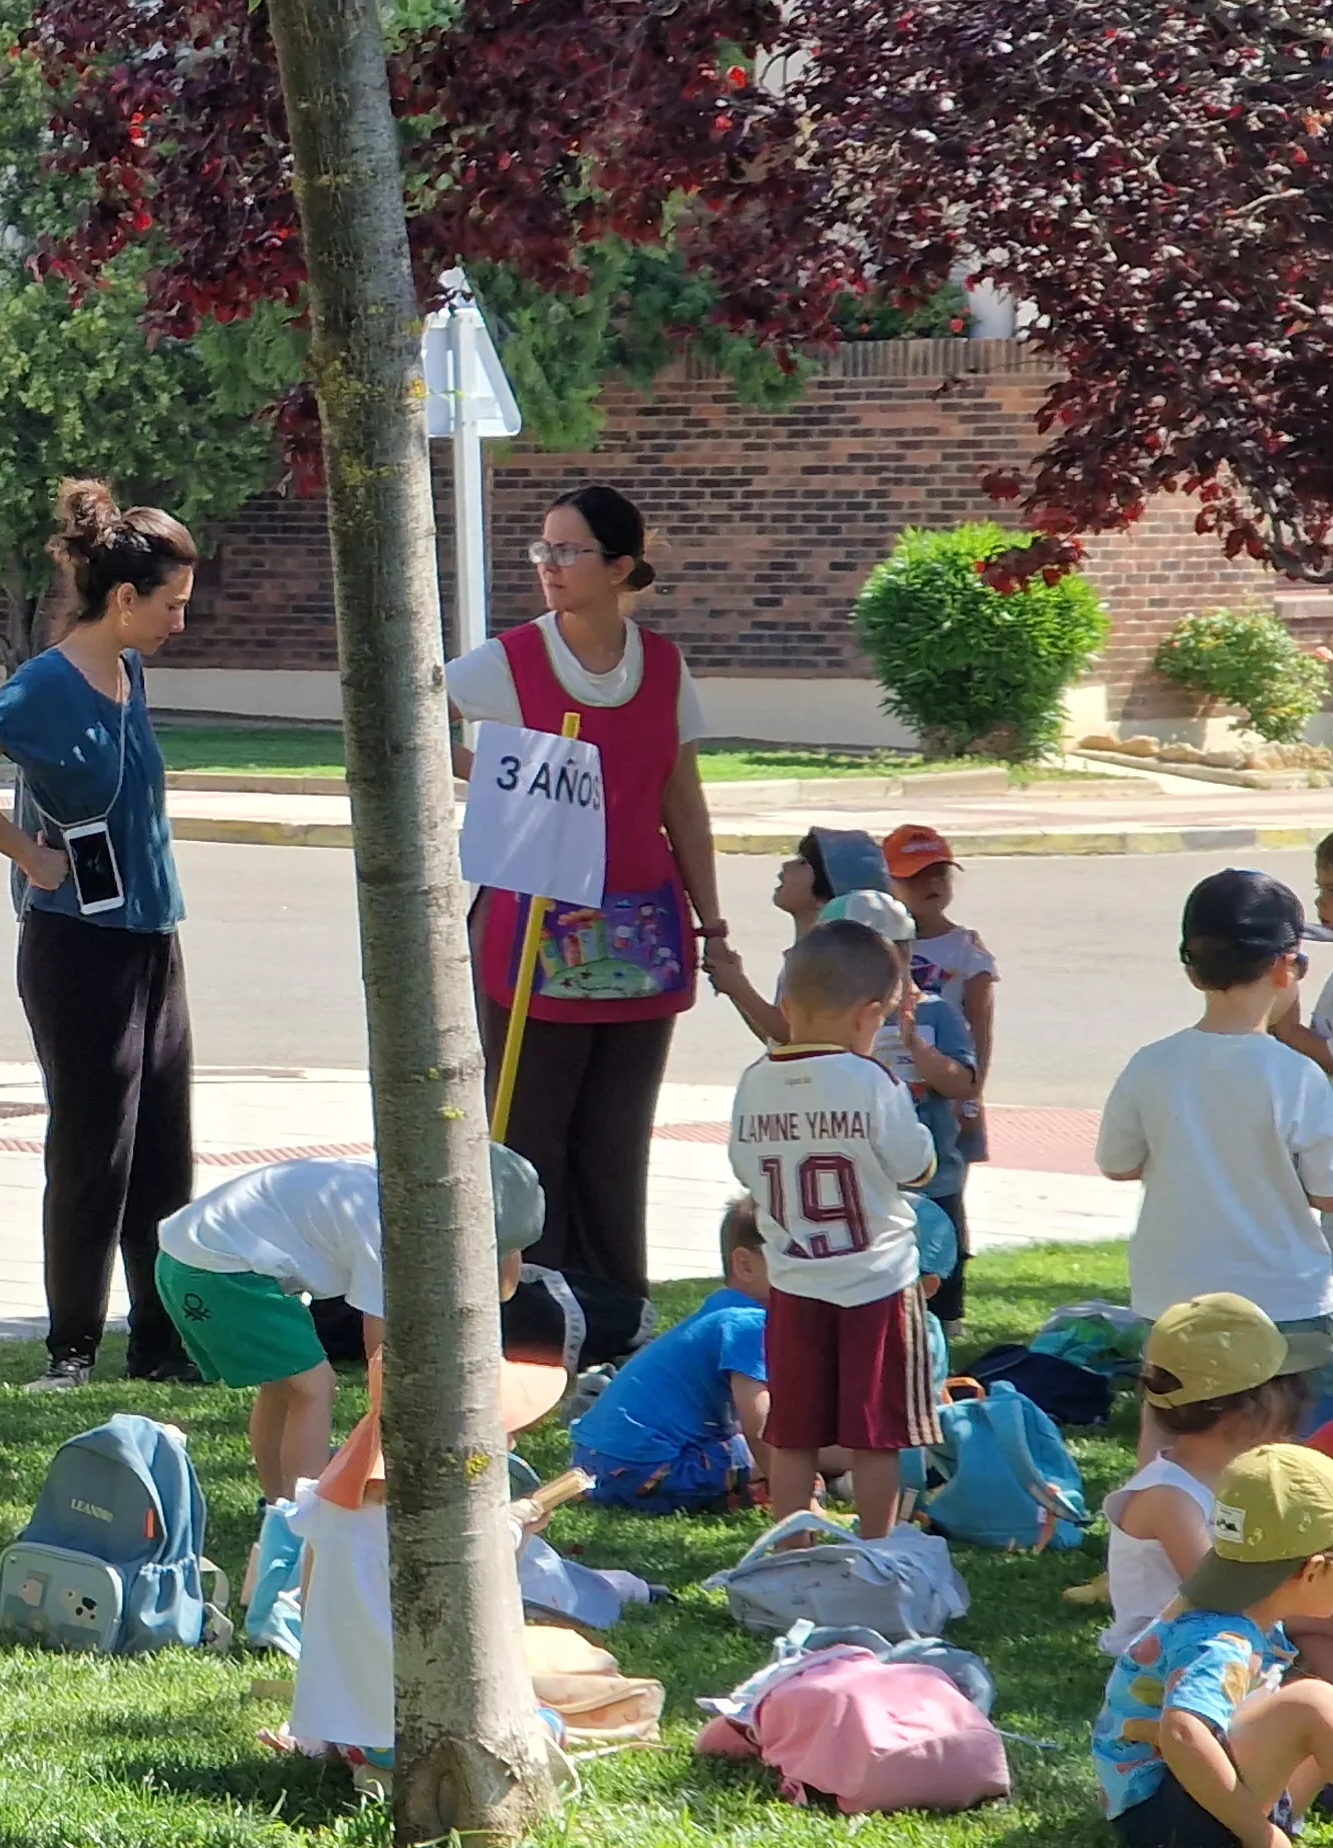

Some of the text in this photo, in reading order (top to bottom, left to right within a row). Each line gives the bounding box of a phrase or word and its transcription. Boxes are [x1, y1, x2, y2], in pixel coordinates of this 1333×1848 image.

[496, 755, 602, 811] 3 AÑOS
[737, 1112, 801, 1144] LAMINE
[758, 1152, 871, 1260] 19
[70, 1498, 114, 1524] LEANDRO
